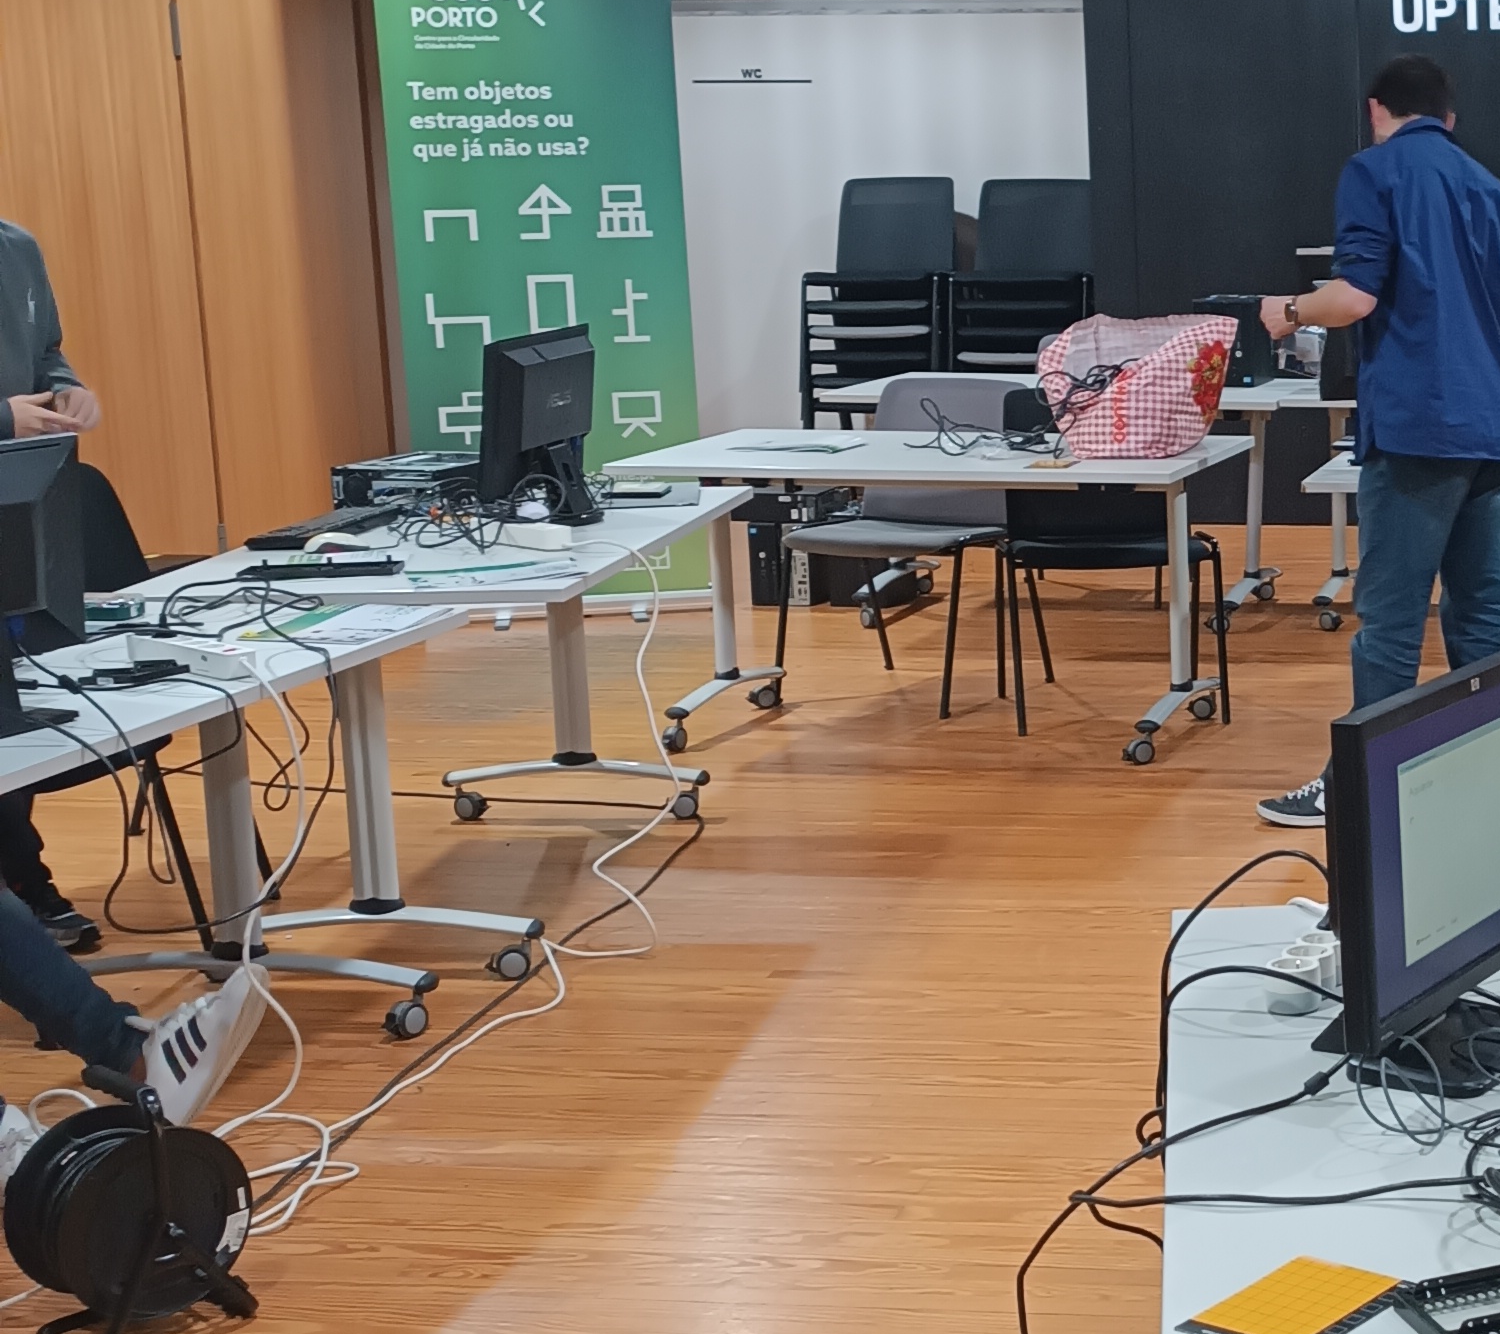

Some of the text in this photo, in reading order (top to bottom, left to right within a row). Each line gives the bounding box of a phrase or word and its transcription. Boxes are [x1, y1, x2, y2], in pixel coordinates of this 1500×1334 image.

[410, 6, 498, 28] PORTO
[741, 68, 762, 78] WC
[406, 80, 552, 105] Tem objetos
[409, 108, 574, 133] estragados ou
[412, 136, 590, 163] que já não usa?
